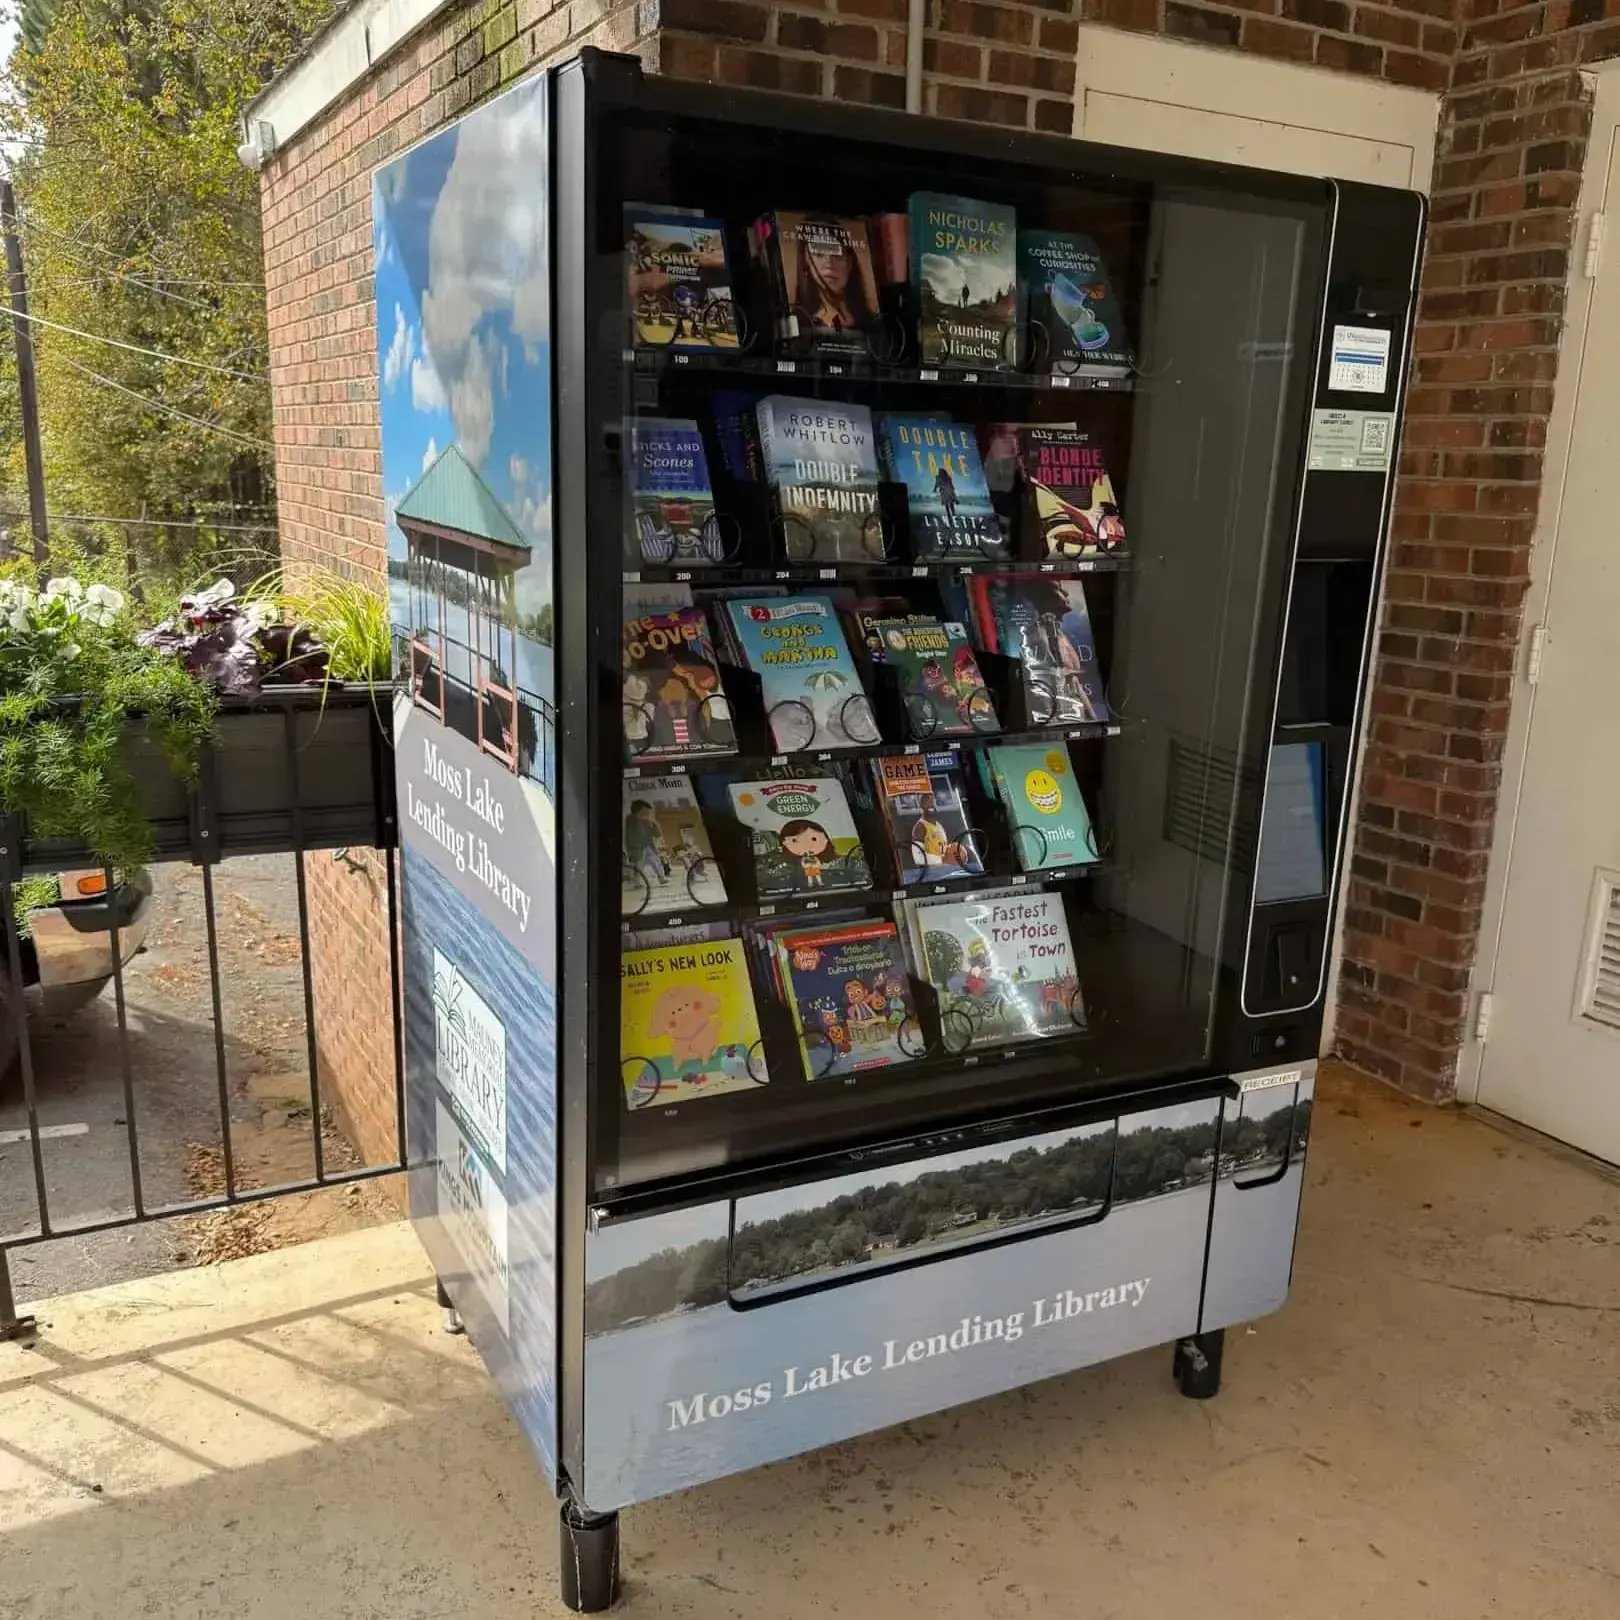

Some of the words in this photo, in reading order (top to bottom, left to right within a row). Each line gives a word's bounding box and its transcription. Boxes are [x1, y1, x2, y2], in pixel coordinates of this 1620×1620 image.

[929, 211, 1007, 236] NICHOLAS
[935, 232, 1001, 254] SPARKS
[649, 251, 700, 267] SONIC
[1027, 248, 1063, 260] COFFEE
[1064, 250, 1091, 262] SHOP
[666, 265, 700, 276] PRIME
[1039, 259, 1097, 273] CURIOSITIES
[936, 317, 1002, 345] Counting
[940, 339, 999, 360] Miracles
[789, 413, 857, 432] ROBERT
[783, 427, 865, 445] WHITLOW
[897, 425, 969, 449] DOUBLE
[676, 443, 700, 452] AND
[1040, 447, 1104, 467] BLONDE
[643, 453, 694, 470] Scones
[794, 459, 859, 484] DOUBLE
[911, 450, 970, 477] TAKE
[1036, 467, 1105, 487] IDENTITY
[785, 486, 876, 513] INDEMNITY
[905, 634, 949, 650] FRIENDS
[762, 646, 838, 664] MARTHA
[884, 763, 927, 778] GAME
[423, 738, 463, 799] Moss
[465, 767, 504, 835] Lake
[776, 795, 808, 806] GREEN
[777, 804, 816, 815] ENERGY
[1037, 823, 1076, 844] Smile
[407, 781, 464, 873] Lending
[467, 831, 531, 933] Library
[992, 900, 1048, 923] Fastest
[991, 923, 1058, 943] Tortoise
[1029, 942, 1066, 958] Town
[620, 958, 665, 978] SALLY'S
[669, 954, 697, 971] NEW
[700, 949, 733, 967] LOOK
[437, 1014, 504, 1137] LIBRARY
[666, 1381, 772, 1431] Moss
[783, 1353, 872, 1397] Lake
[881, 1311, 1024, 1371] Lending
[1032, 1277, 1151, 1327] Library
